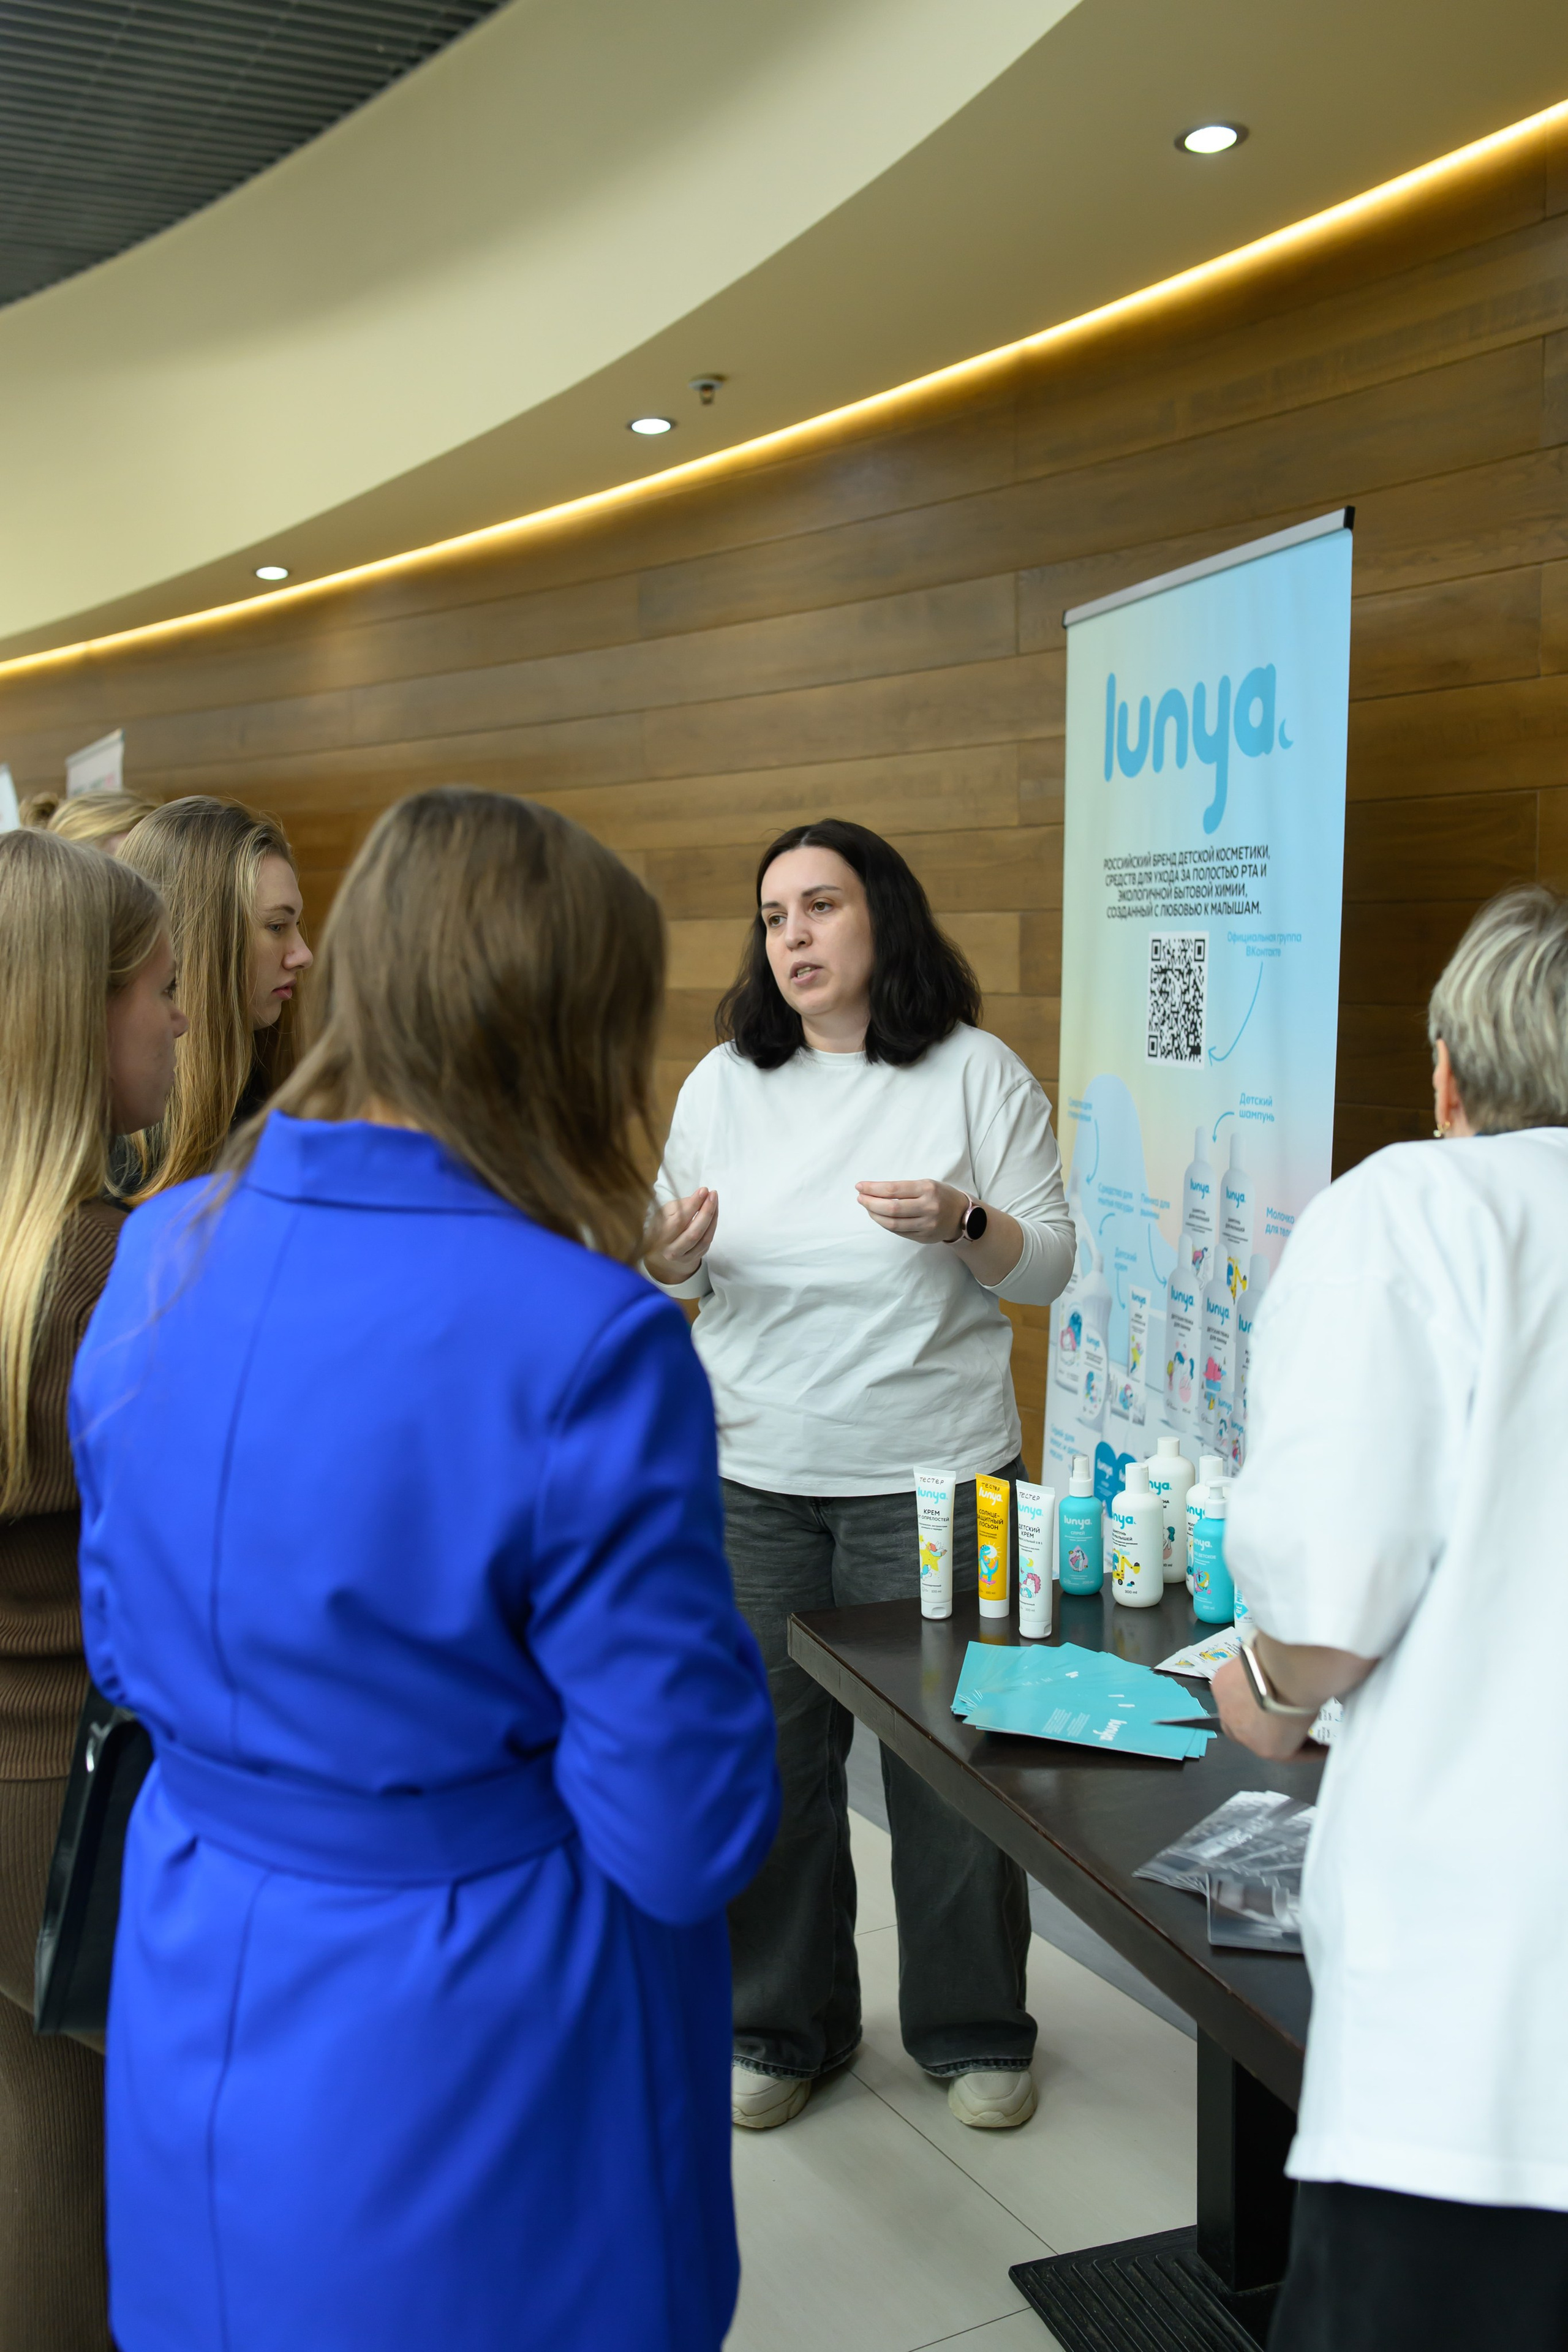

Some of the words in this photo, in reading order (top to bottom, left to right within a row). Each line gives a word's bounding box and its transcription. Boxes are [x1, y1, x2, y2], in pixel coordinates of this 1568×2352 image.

[1104, 663, 1276, 835] lunya
[1103, 852, 1152, 870] РОССИЙСКИЙ
[1153, 852, 1177, 867] БРЕНД
[1178, 846, 1214, 867] ДЕТСКОЙ
[1216, 845, 1270, 861] КОСМЕТИКИ,
[1105, 873, 1136, 887] СРЕДСТВ
[1137, 872, 1152, 886] ДЛЯ
[1153, 869, 1179, 885] УХОДА
[1181, 869, 1191, 881] ЗА
[1193, 865, 1239, 881] ПОЛОСТЬЮ
[1241, 864, 1258, 878] РТА
[1260, 863, 1267, 877] И
[1174, 881, 1213, 900] БЫТОВОЙ
[1215, 883, 1248, 898] ХИМИИ,
[1106, 902, 1153, 920] СОЗДАННЫЙ
[1154, 904, 1159, 918] С
[1159, 903, 1202, 918] ЛЮБОВЬЮ
[1204, 902, 1208, 916] К
[1210, 900, 1262, 915] МАЛЫШАМ.
[1227, 931, 1276, 944] Официальная
[1276, 933, 1302, 944] группа
[1246, 945, 1281, 957] ВКонтакте
[1240, 1092, 1273, 1107] Детский
[1239, 1109, 1275, 1123] шампунь
[1266, 1207, 1295, 1224] Молочко
[1265, 1224, 1279, 1235] для
[1280, 1226, 1291, 1237] тел
[1149, 1480, 1170, 1495] nya
[918, 1487, 947, 1504] lunya
[979, 1487, 1002, 1506] lunya
[979, 1509, 1000, 1518] СОЛНЦЕ-
[1112, 1512, 1134, 1529] nya
[979, 1520, 998, 1530] ЛОСЬОН
[1064, 1515, 1091, 1530] lunya
[1194, 1539, 1211, 1551] nya
[1235, 1605, 1242, 1614] RE
